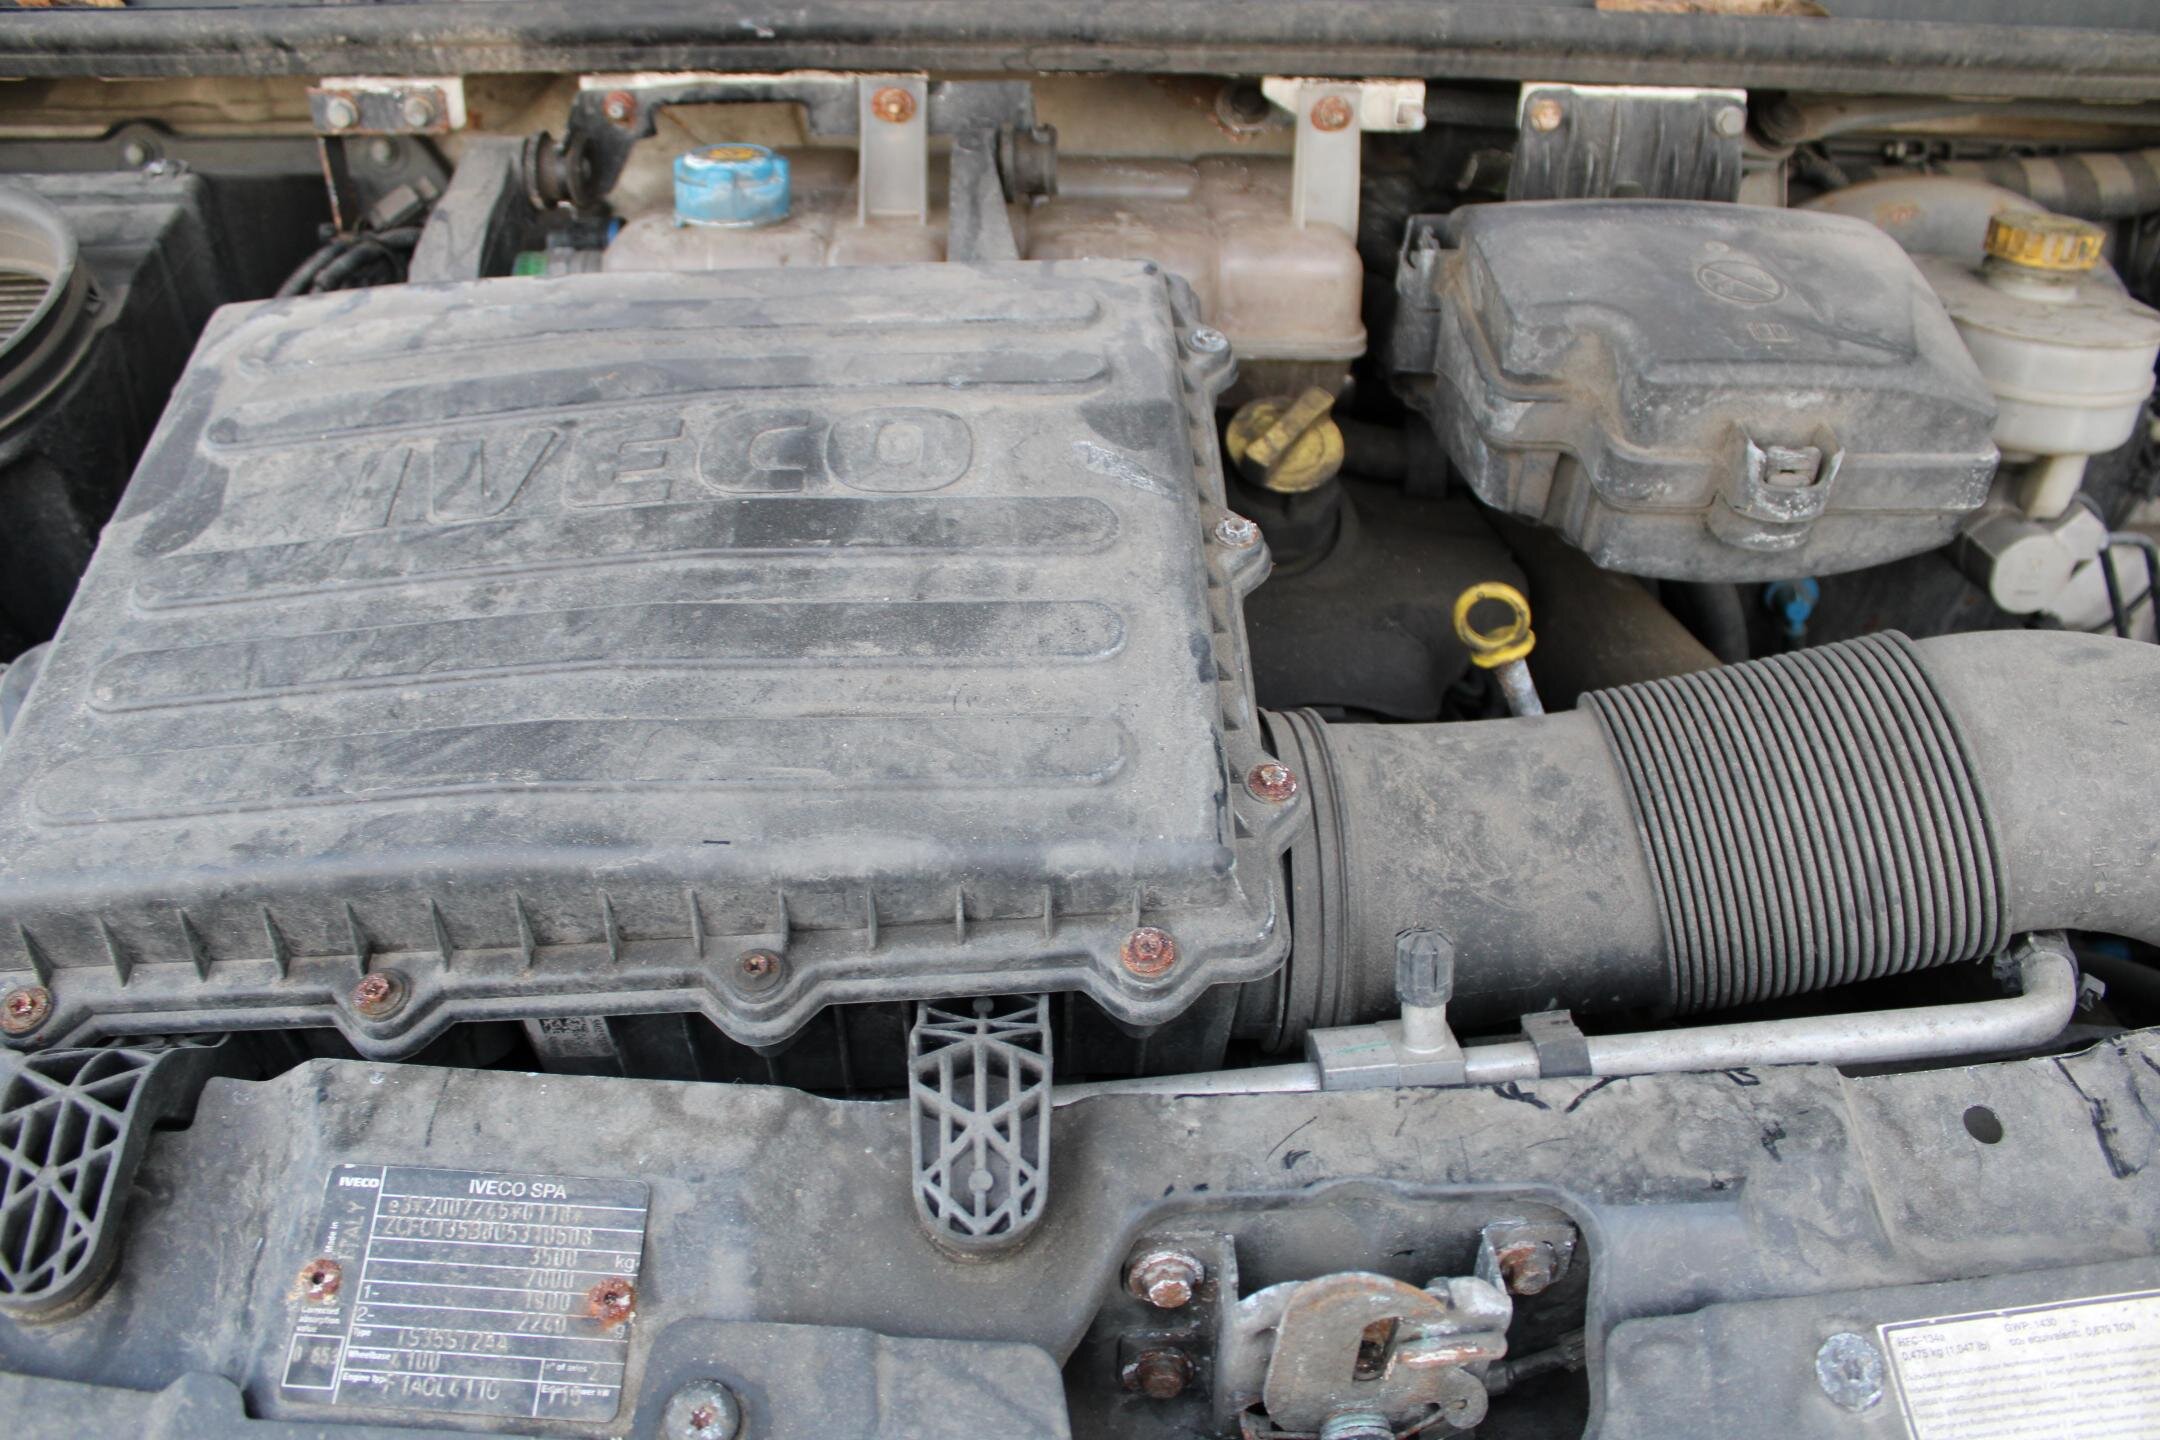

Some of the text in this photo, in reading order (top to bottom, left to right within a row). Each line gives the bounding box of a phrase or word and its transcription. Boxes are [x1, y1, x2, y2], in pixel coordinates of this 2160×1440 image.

[340, 405, 973, 536] IVECO
[339, 1177, 380, 1188] IVECO
[469, 1180, 567, 1199] IVECO SPA
[615, 1255, 636, 1273] kg
